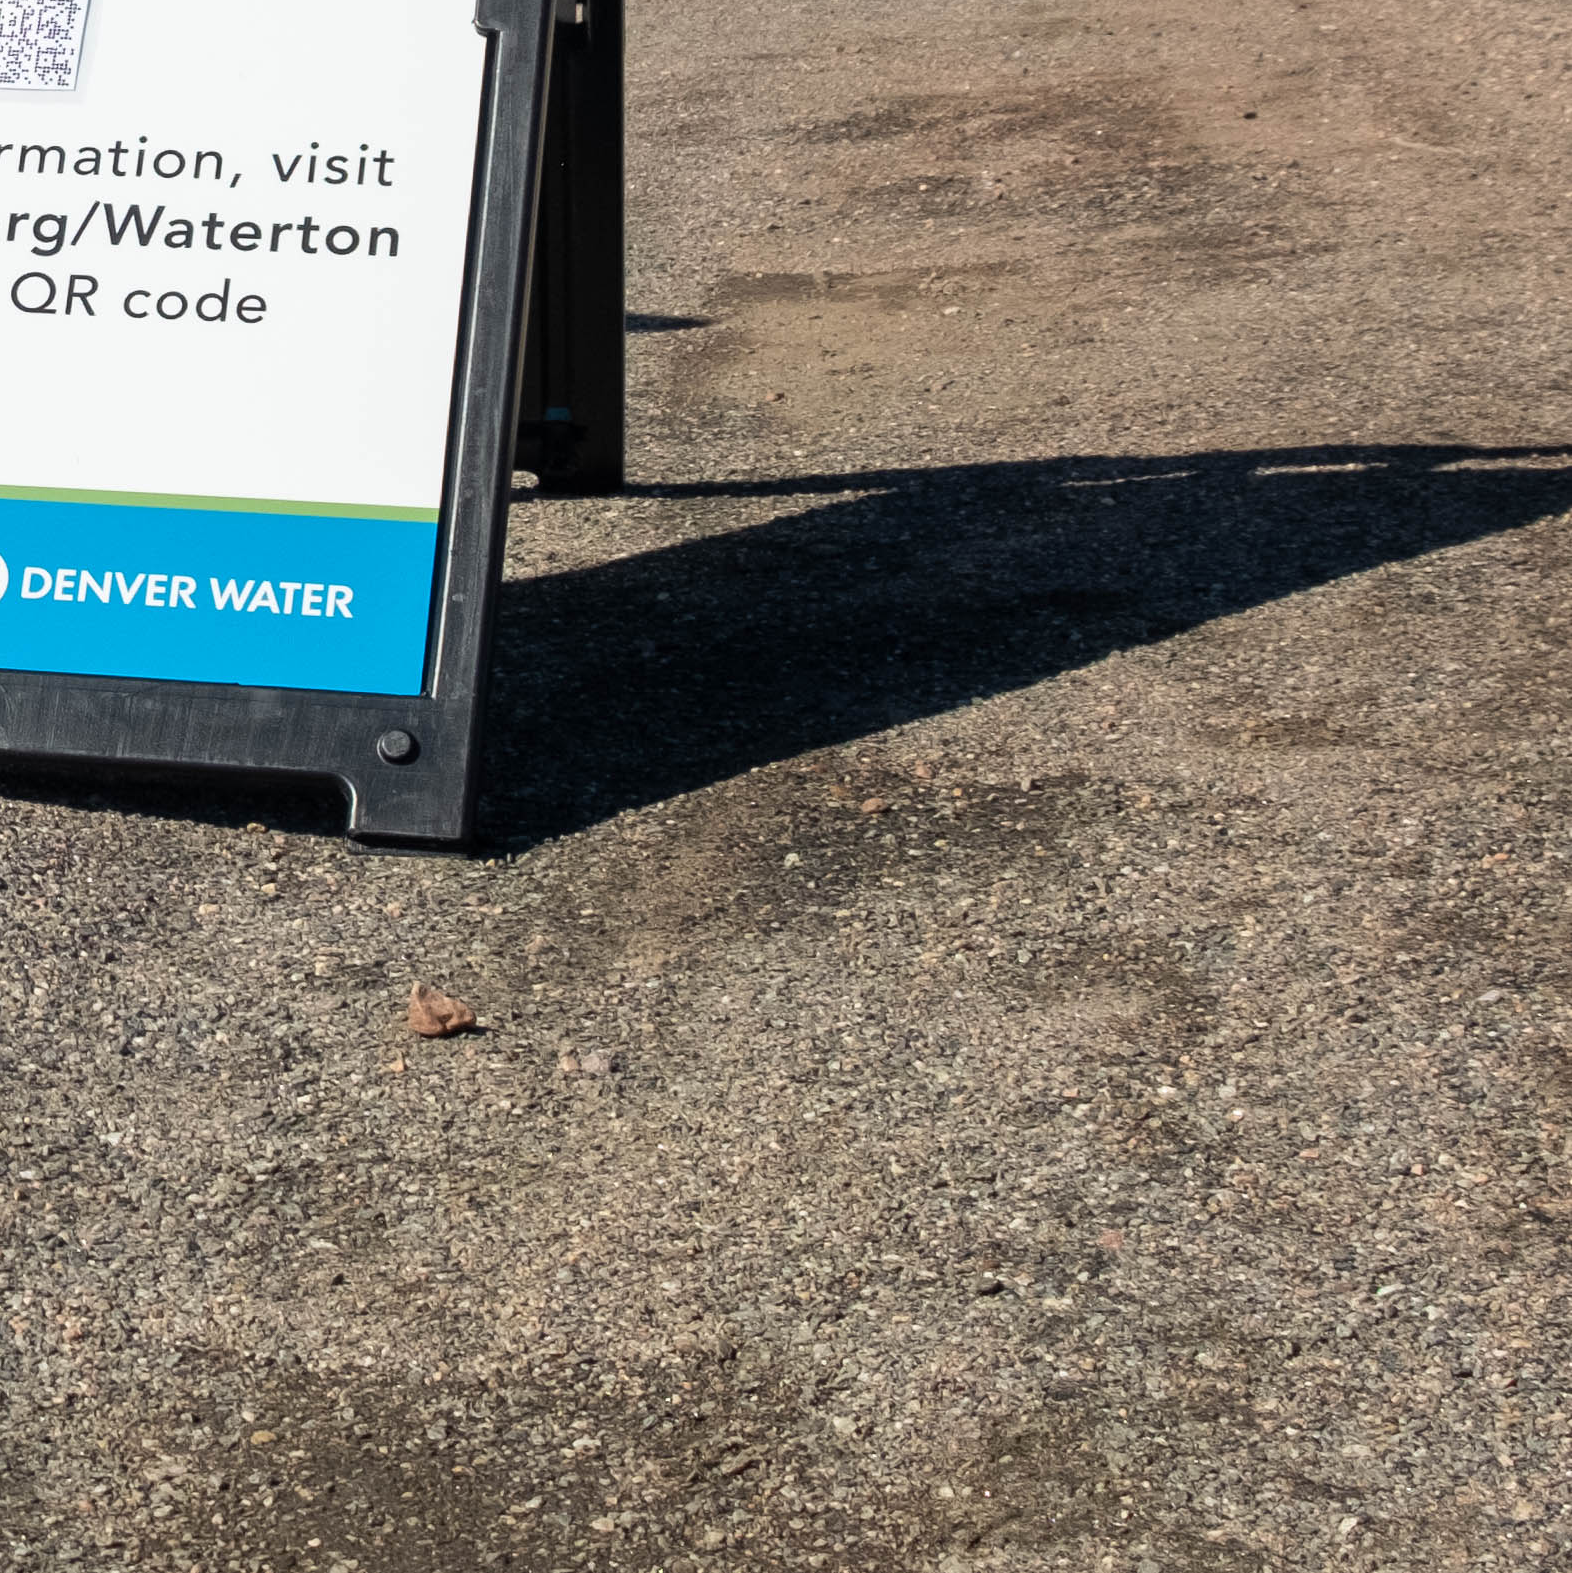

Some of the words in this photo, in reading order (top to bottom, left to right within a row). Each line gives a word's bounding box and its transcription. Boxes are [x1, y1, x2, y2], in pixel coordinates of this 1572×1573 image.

[272, 140, 395, 187] visit
[10, 271, 99, 317] QR
[123, 278, 267, 324] code
[20, 566, 197, 609] DENVER
[209, 577, 354, 618] WATER
